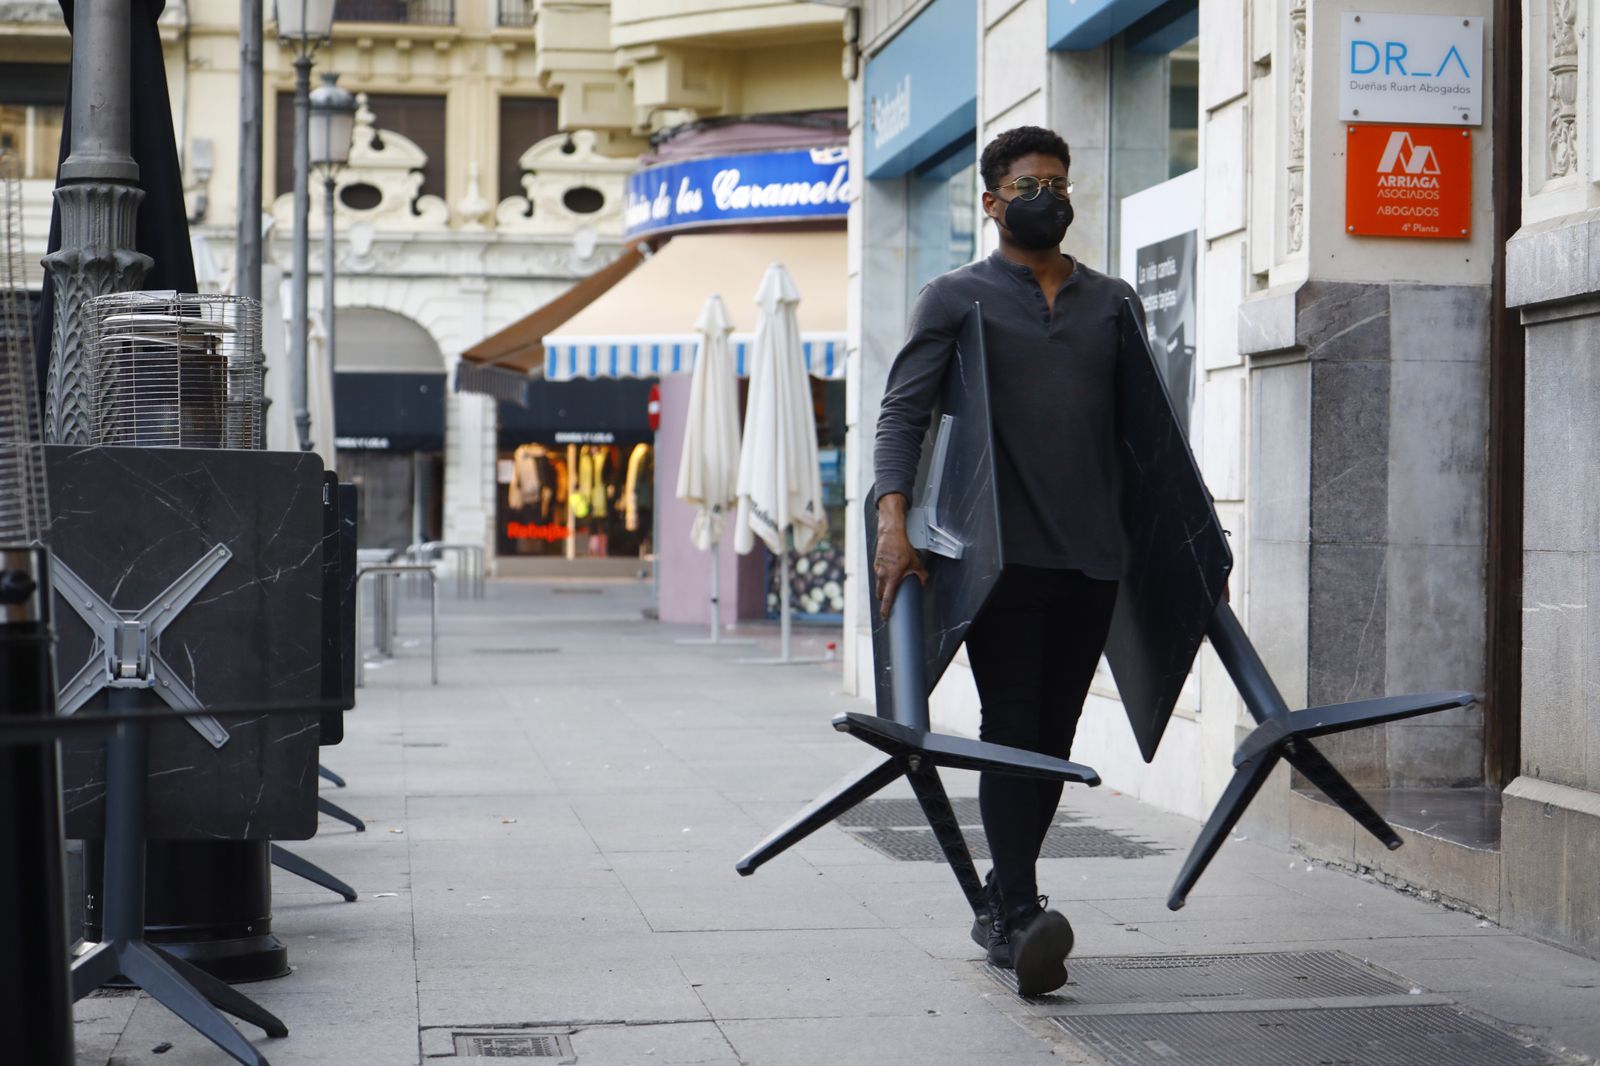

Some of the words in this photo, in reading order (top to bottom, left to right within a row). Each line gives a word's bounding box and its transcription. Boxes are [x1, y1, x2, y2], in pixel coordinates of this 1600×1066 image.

[1350, 80, 1388, 92] Dueñas
[1390, 81, 1417, 93] Ruart
[1419, 82, 1471, 96] Abogados
[1377, 174, 1440, 189] ARRIAGA
[1377, 188, 1440, 200] ASOCIADOS
[1377, 205, 1440, 217] ABOGADOS
[1413, 223, 1439, 233] Planta
